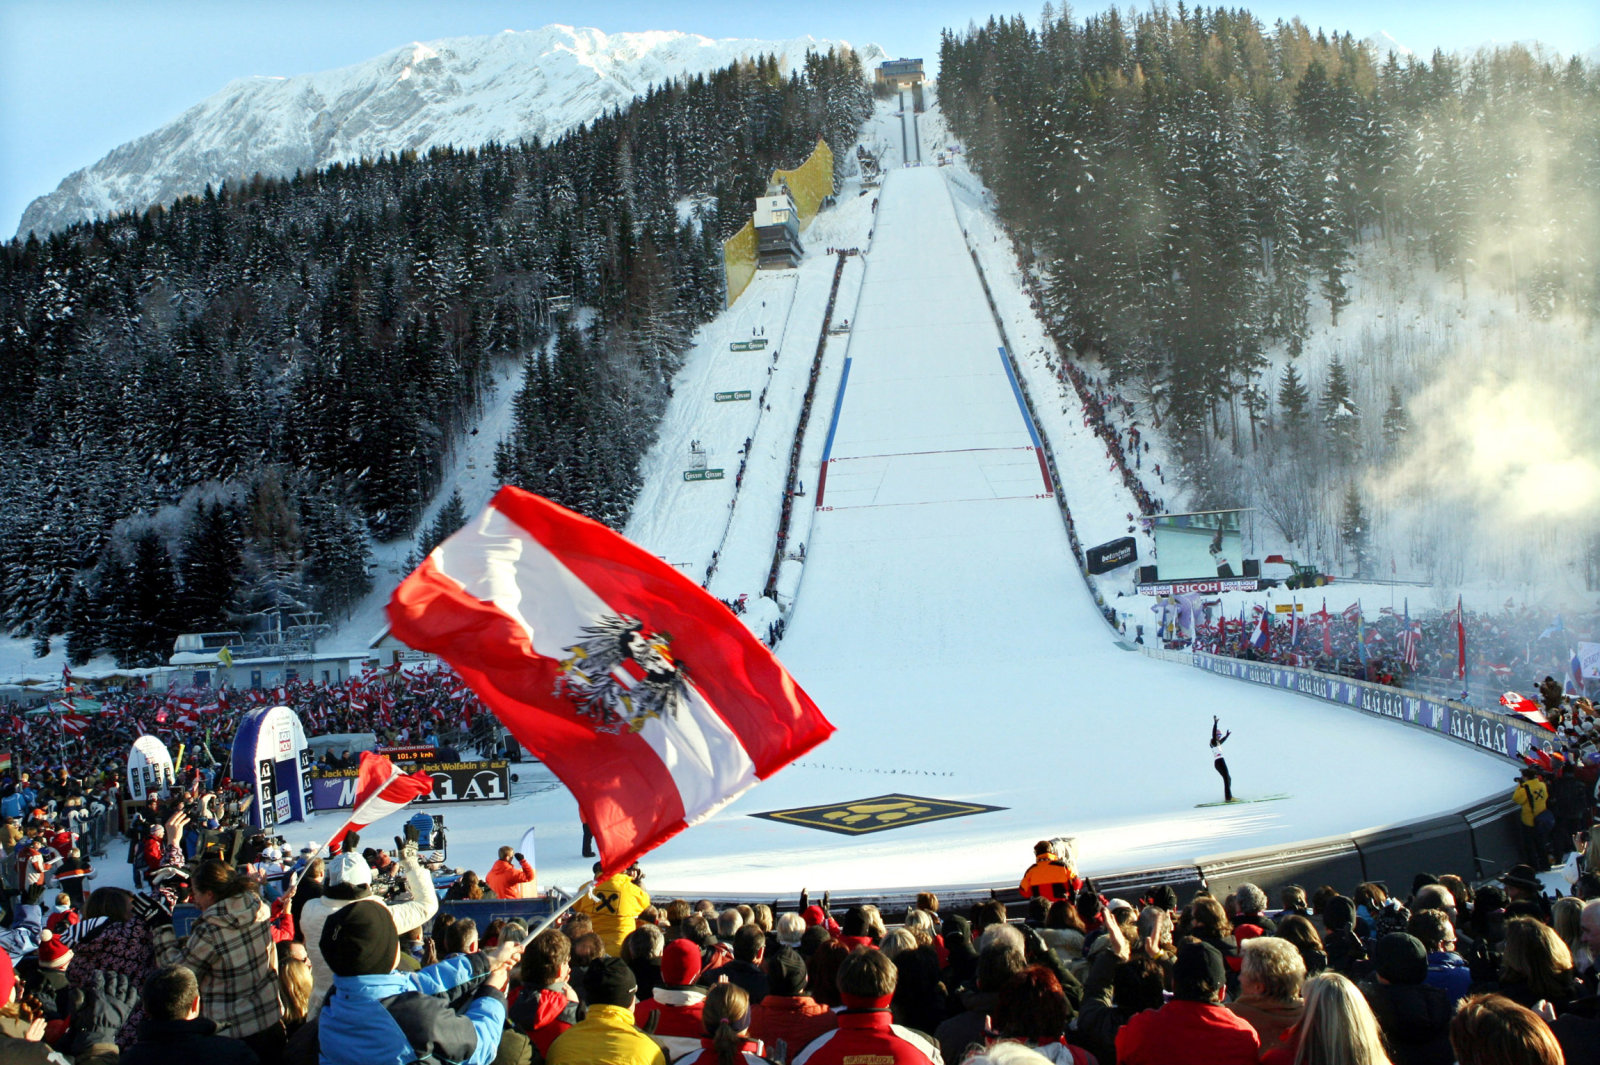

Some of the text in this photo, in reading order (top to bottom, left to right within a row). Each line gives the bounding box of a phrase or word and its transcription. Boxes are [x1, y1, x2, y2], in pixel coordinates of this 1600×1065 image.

[1176, 583, 1218, 594] RICOH
[1362, 688, 1370, 709] A1
[1370, 691, 1380, 713] A1
[1382, 693, 1392, 716] A1
[1393, 695, 1403, 718] A1
[1451, 710, 1462, 737] A1
[1463, 714, 1475, 742] A1
[1478, 719, 1491, 748] A1
[1493, 723, 1507, 754] A1
[397, 752, 418, 760] 101.9
[423, 762, 477, 771] Jack Wolfskin
[323, 769, 342, 778] Jack
[461, 771, 505, 800] A1
